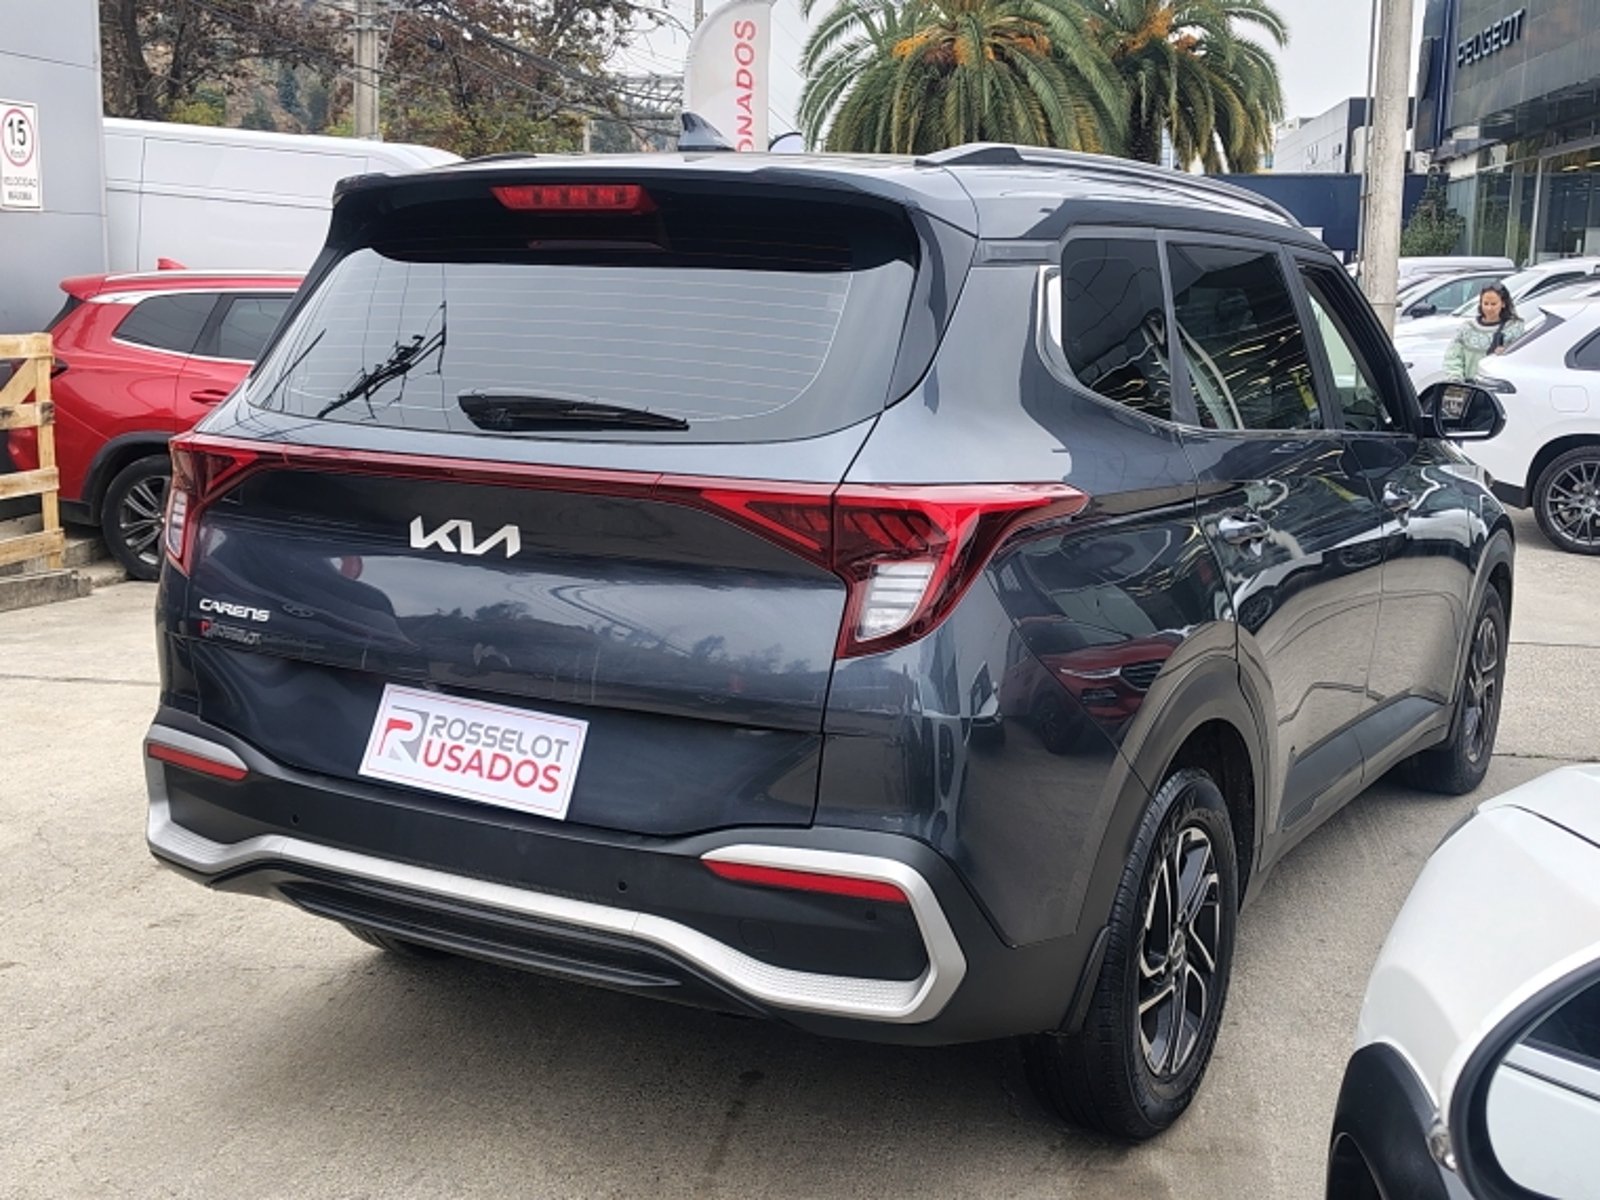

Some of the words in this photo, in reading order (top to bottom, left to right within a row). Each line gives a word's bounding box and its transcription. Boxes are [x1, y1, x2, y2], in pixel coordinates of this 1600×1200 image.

[1457, 6, 1526, 68] PEUGEOT
[8, 118, 26, 146] 15
[410, 515, 521, 558] KIA
[199, 598, 270, 622] CARENS
[430, 715, 569, 763] ROSSELOT
[423, 739, 562, 793] USADOS
